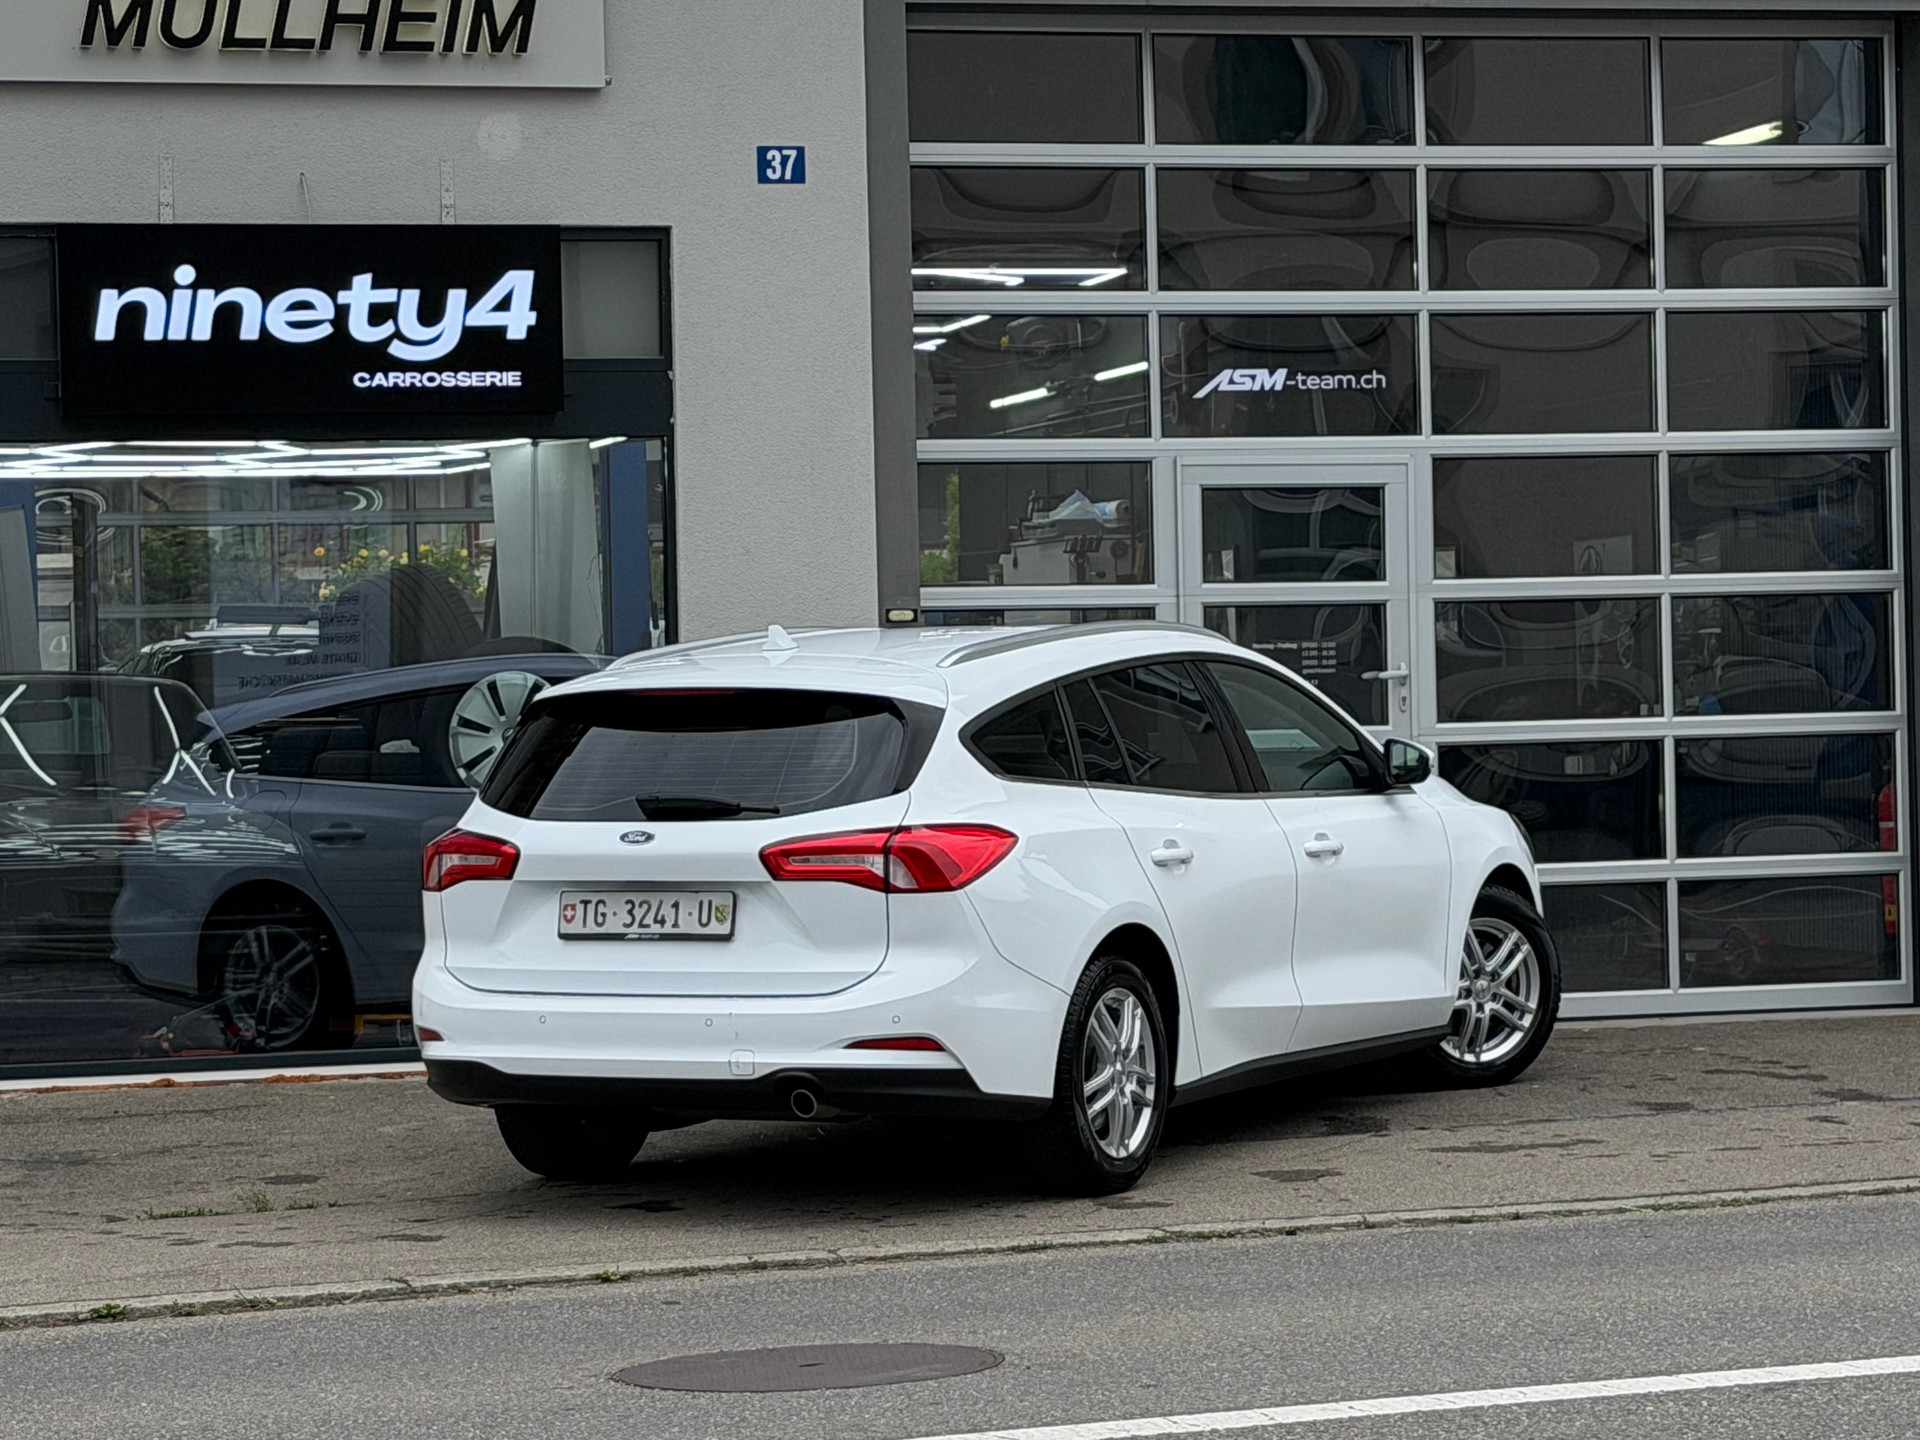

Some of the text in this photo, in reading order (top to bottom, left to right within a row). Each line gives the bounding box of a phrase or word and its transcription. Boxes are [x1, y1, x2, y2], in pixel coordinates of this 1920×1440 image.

[766, 149, 797, 180] 37
[94, 264, 537, 361] ninety4
[353, 371, 522, 387] CARROSSERIE
